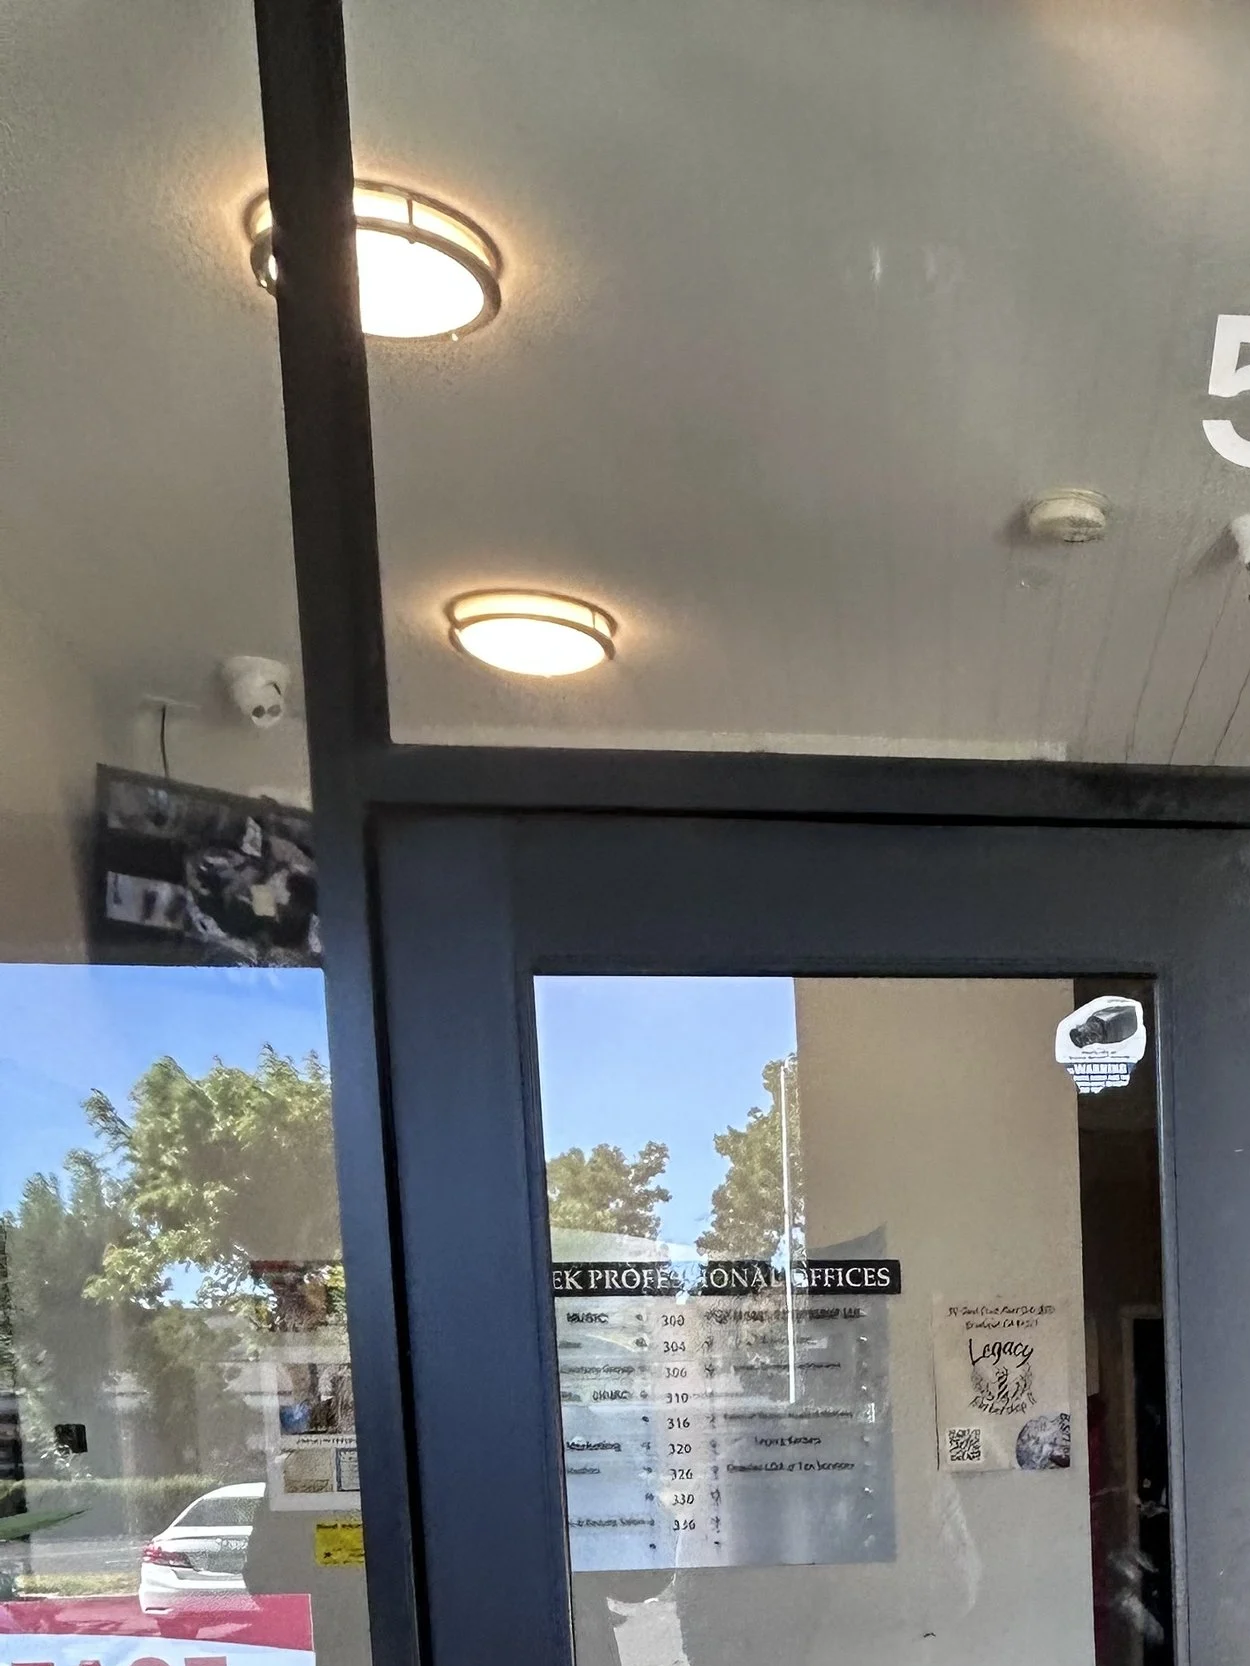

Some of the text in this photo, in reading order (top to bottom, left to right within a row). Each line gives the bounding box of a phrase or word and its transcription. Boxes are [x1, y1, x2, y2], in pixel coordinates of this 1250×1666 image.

[588, 1267, 784, 1290] PROFESIONAL
[968, 1338, 1034, 1369] Legacy
[667, 1417, 691, 1430] 316
[668, 1443, 692, 1456] 320
